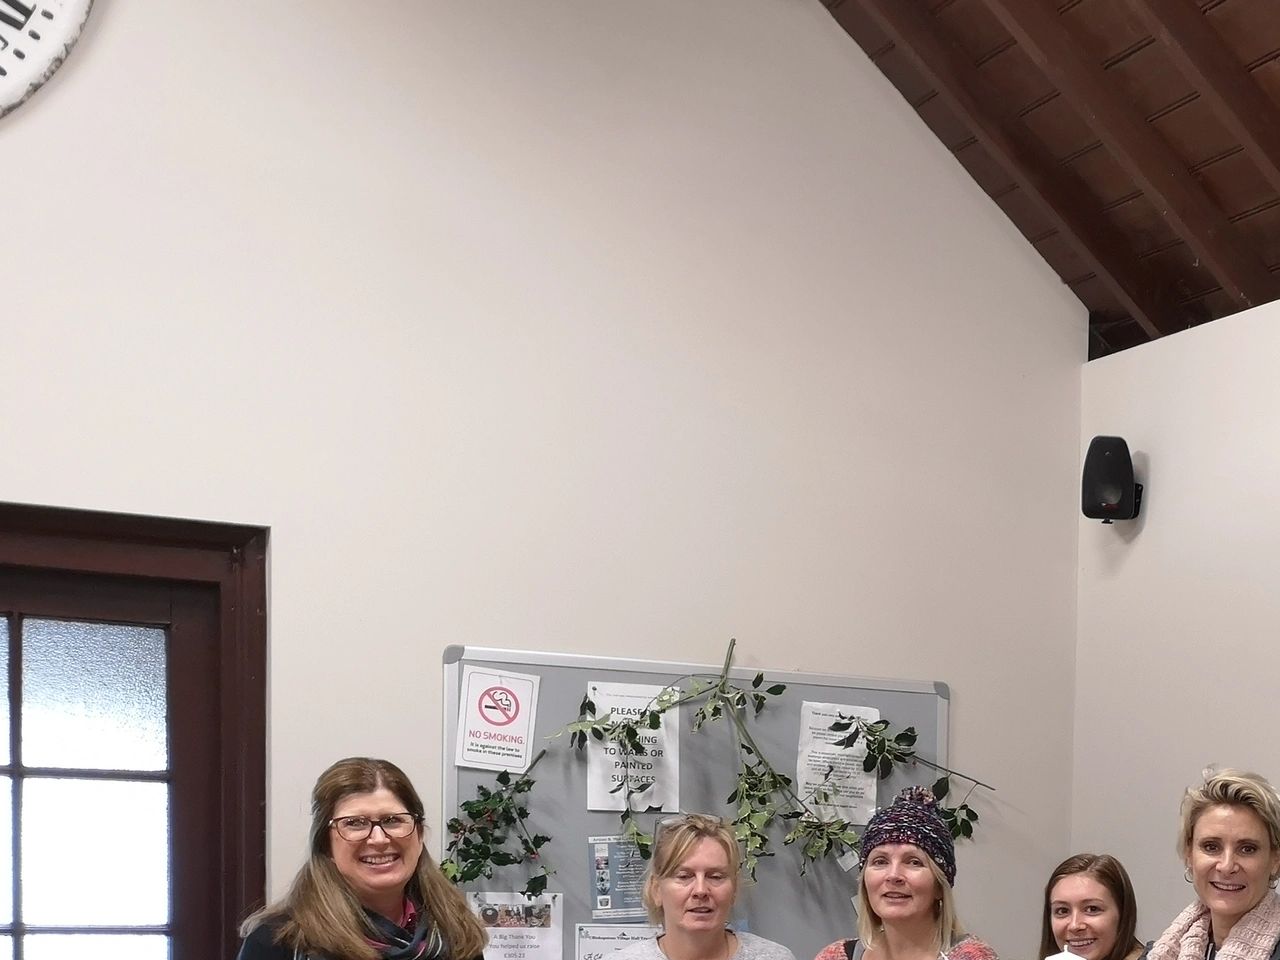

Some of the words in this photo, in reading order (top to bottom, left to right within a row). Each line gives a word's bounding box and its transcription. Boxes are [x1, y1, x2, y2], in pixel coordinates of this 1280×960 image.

[610, 707, 643, 716] PLEASE
[468, 730, 481, 739] NO
[603, 747, 616, 755] TO
[650, 749, 664, 757] OR
[614, 761, 653, 770] PAINTED
